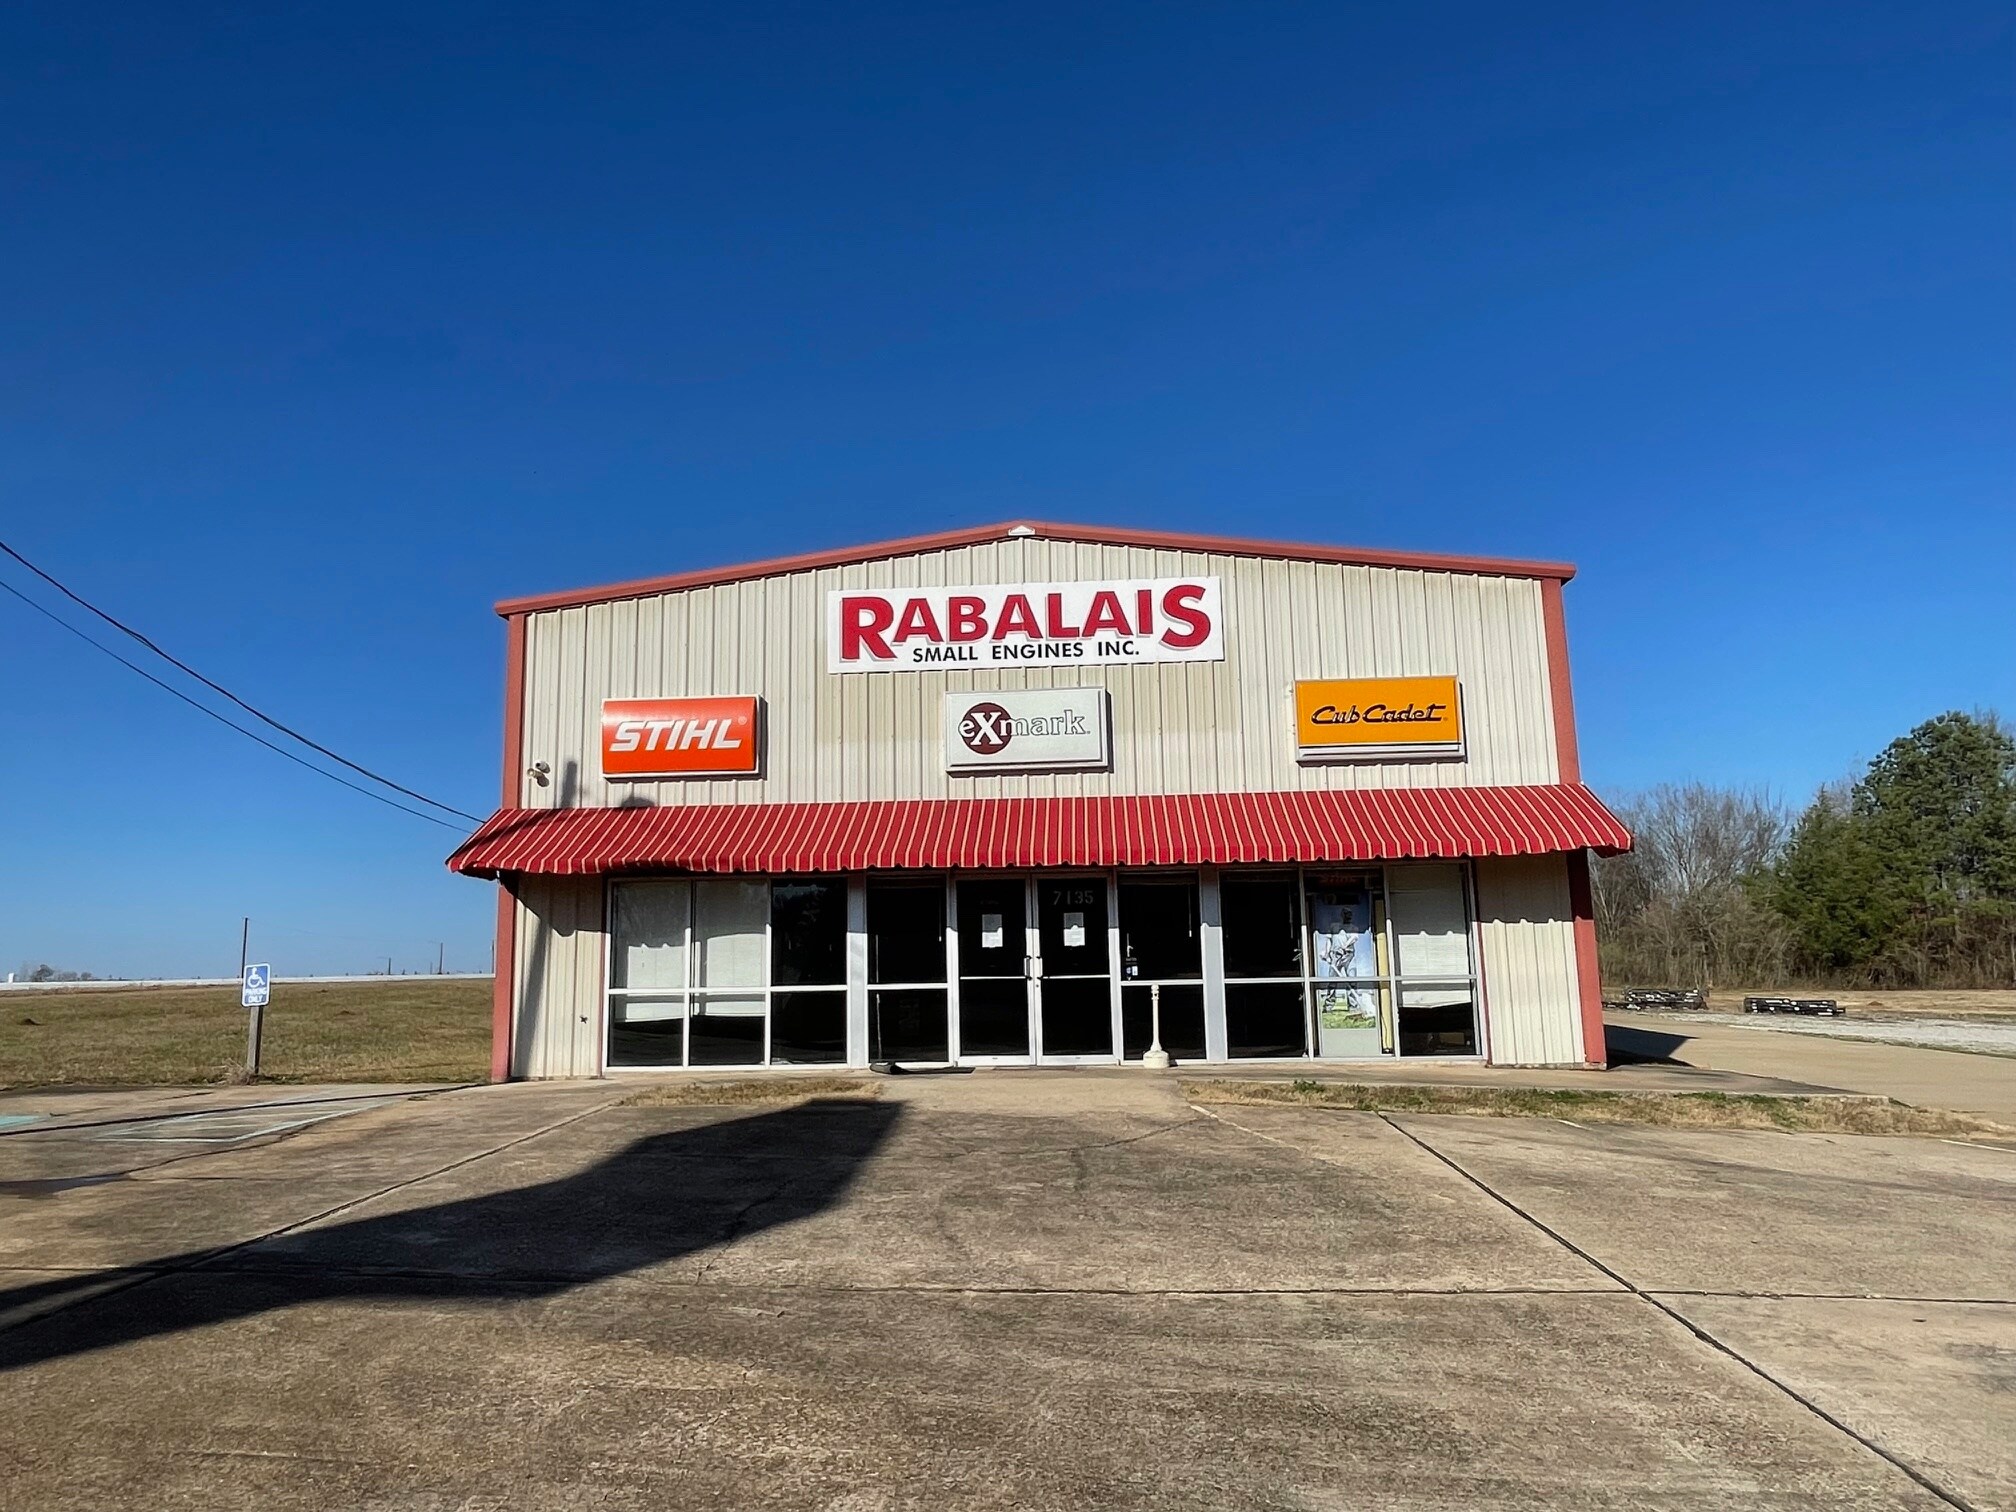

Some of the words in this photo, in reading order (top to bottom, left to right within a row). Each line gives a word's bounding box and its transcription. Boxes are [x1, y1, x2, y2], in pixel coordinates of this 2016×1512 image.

[841, 584, 1212, 660] RABALAIS
[912, 646, 978, 663] SMALL
[992, 642, 1084, 659] ENGINES
[1097, 640, 1140, 656] INC.
[1311, 704, 1361, 725] Cub
[1362, 703, 1447, 724] Cadet
[608, 718, 742, 752] STIHL
[1053, 890, 1094, 906] 7135
